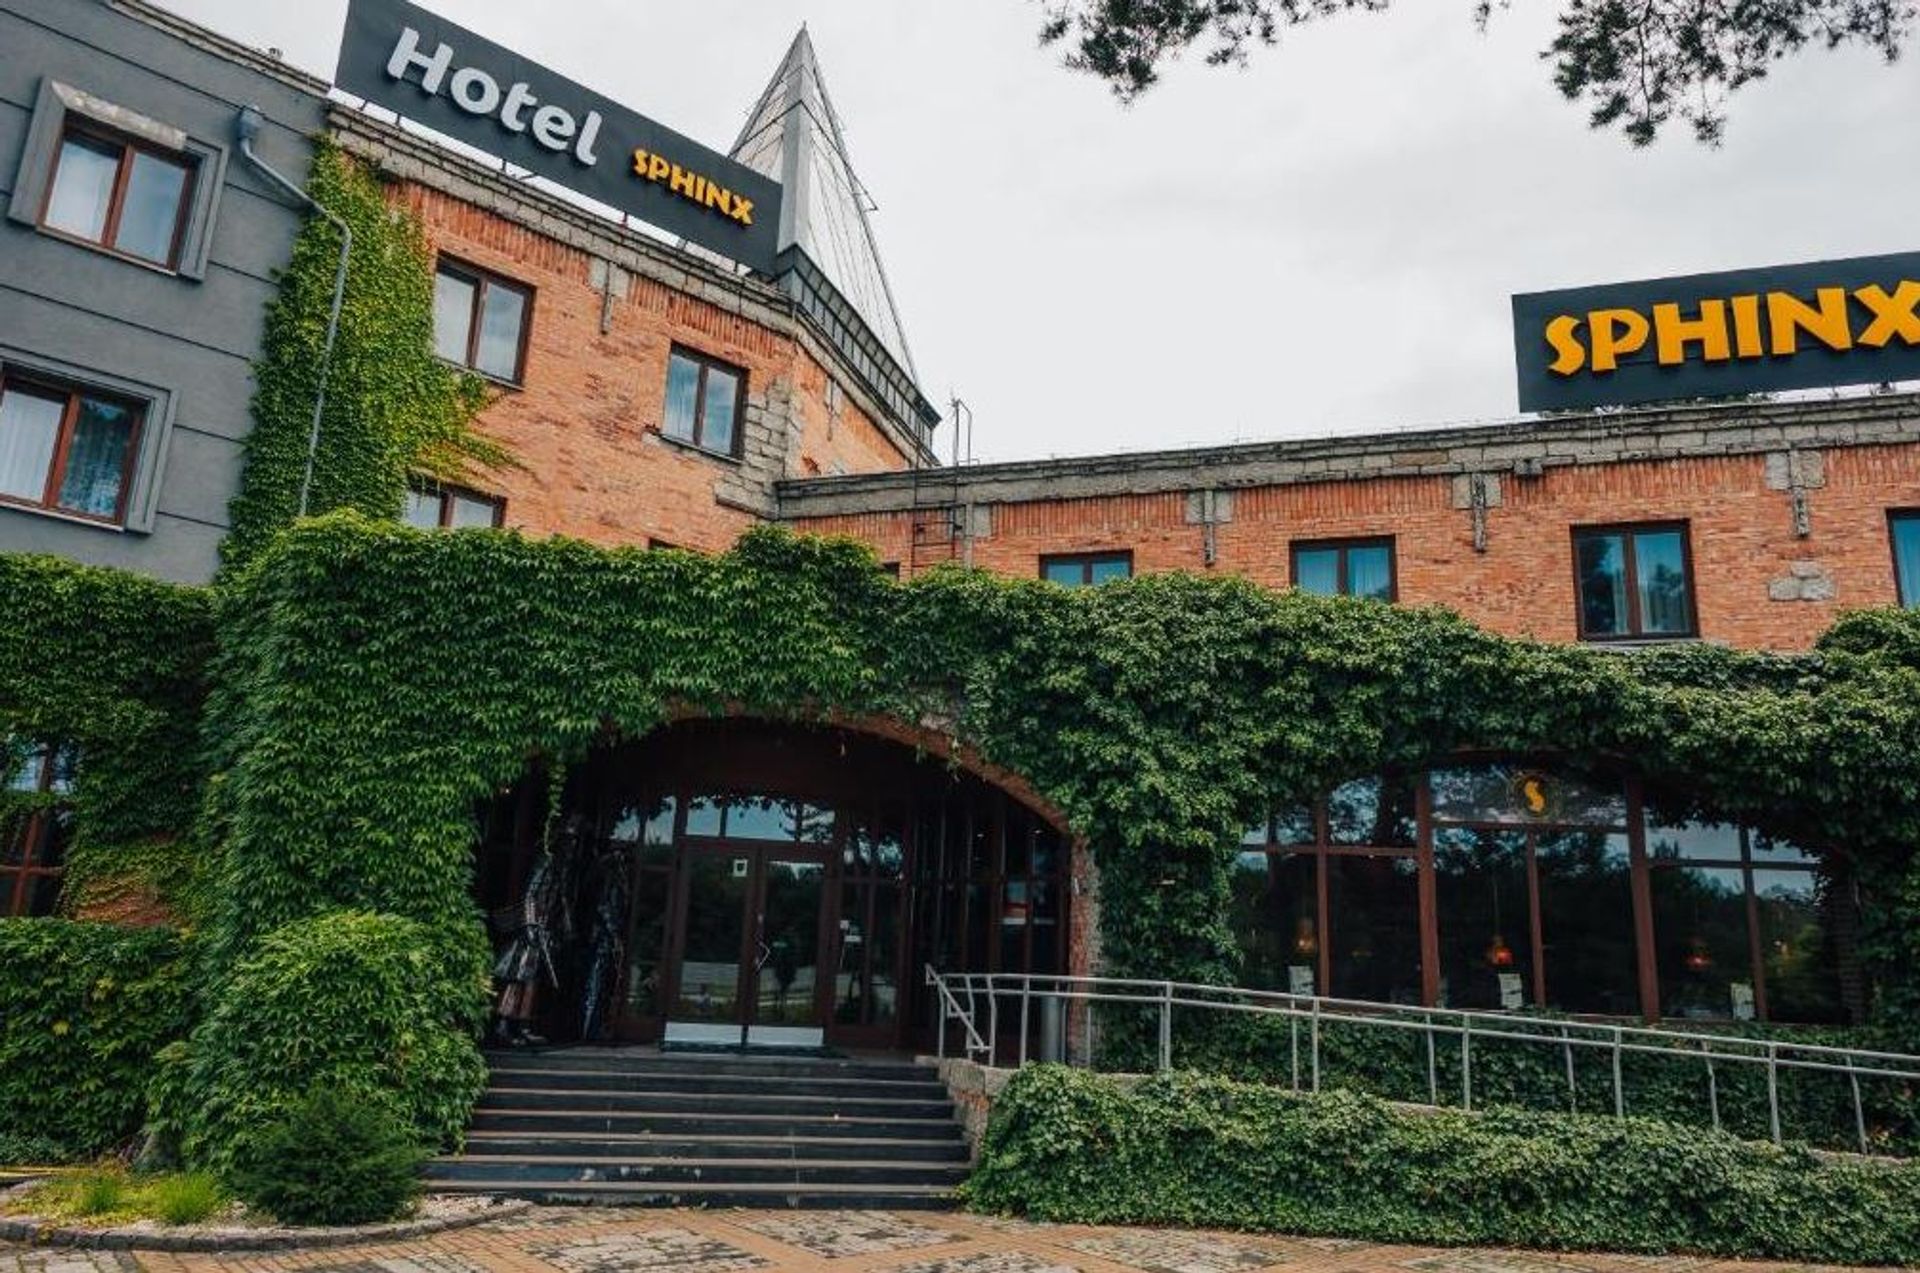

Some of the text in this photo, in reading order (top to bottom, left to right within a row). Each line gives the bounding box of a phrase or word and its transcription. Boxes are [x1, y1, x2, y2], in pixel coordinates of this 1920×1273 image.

[387, 26, 755, 226] Hotel SPHINX
[1545, 280, 1920, 376] SPHINX
